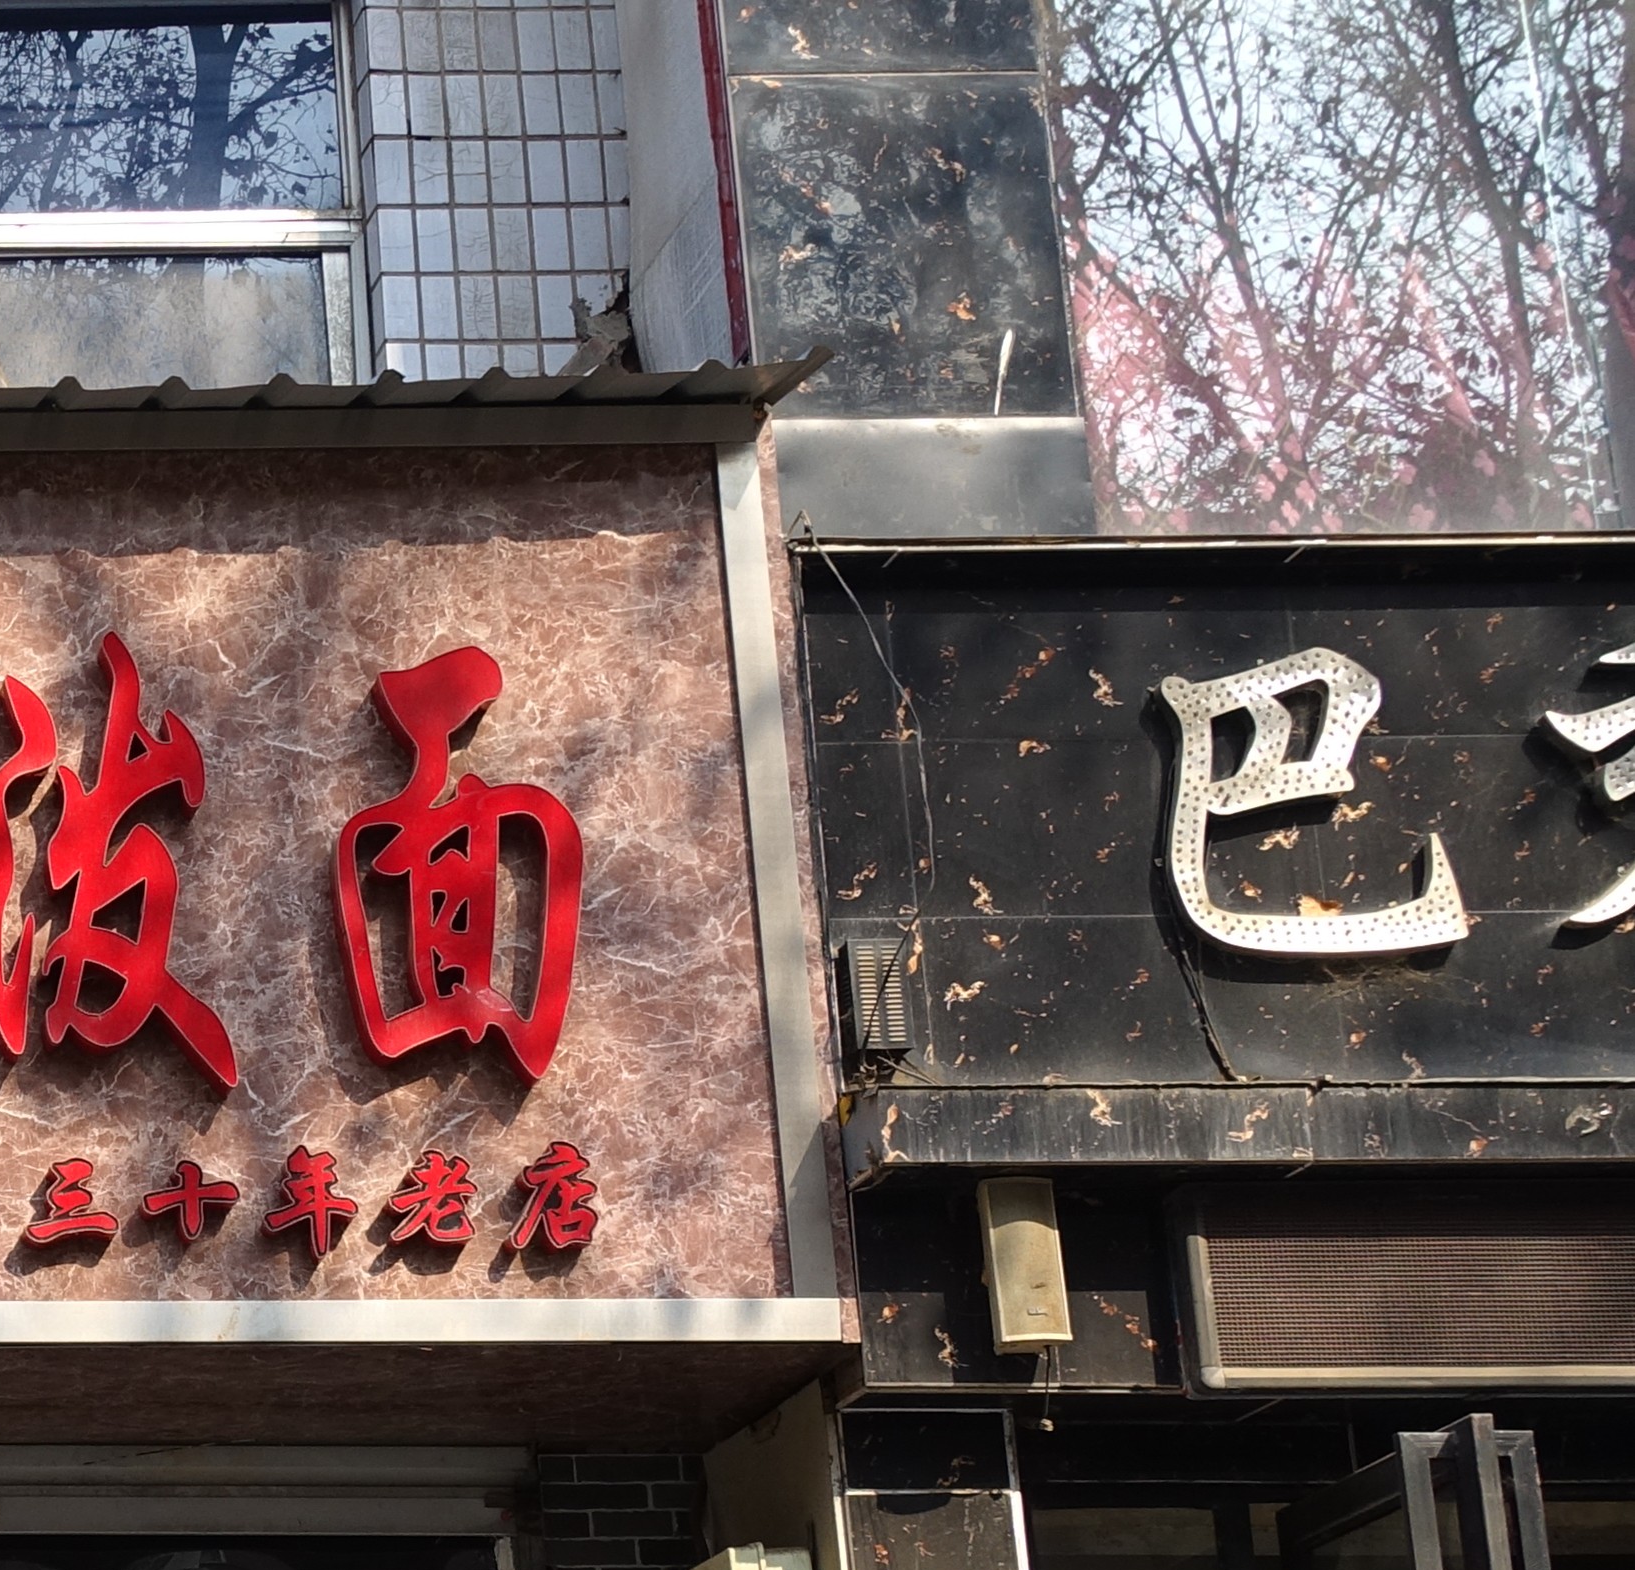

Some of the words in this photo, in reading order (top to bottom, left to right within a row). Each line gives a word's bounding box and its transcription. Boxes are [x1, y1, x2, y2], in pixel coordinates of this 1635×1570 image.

[1161, 640, 1635, 957] 巴
[23, 1141, 599, 1261] 三十年老店
